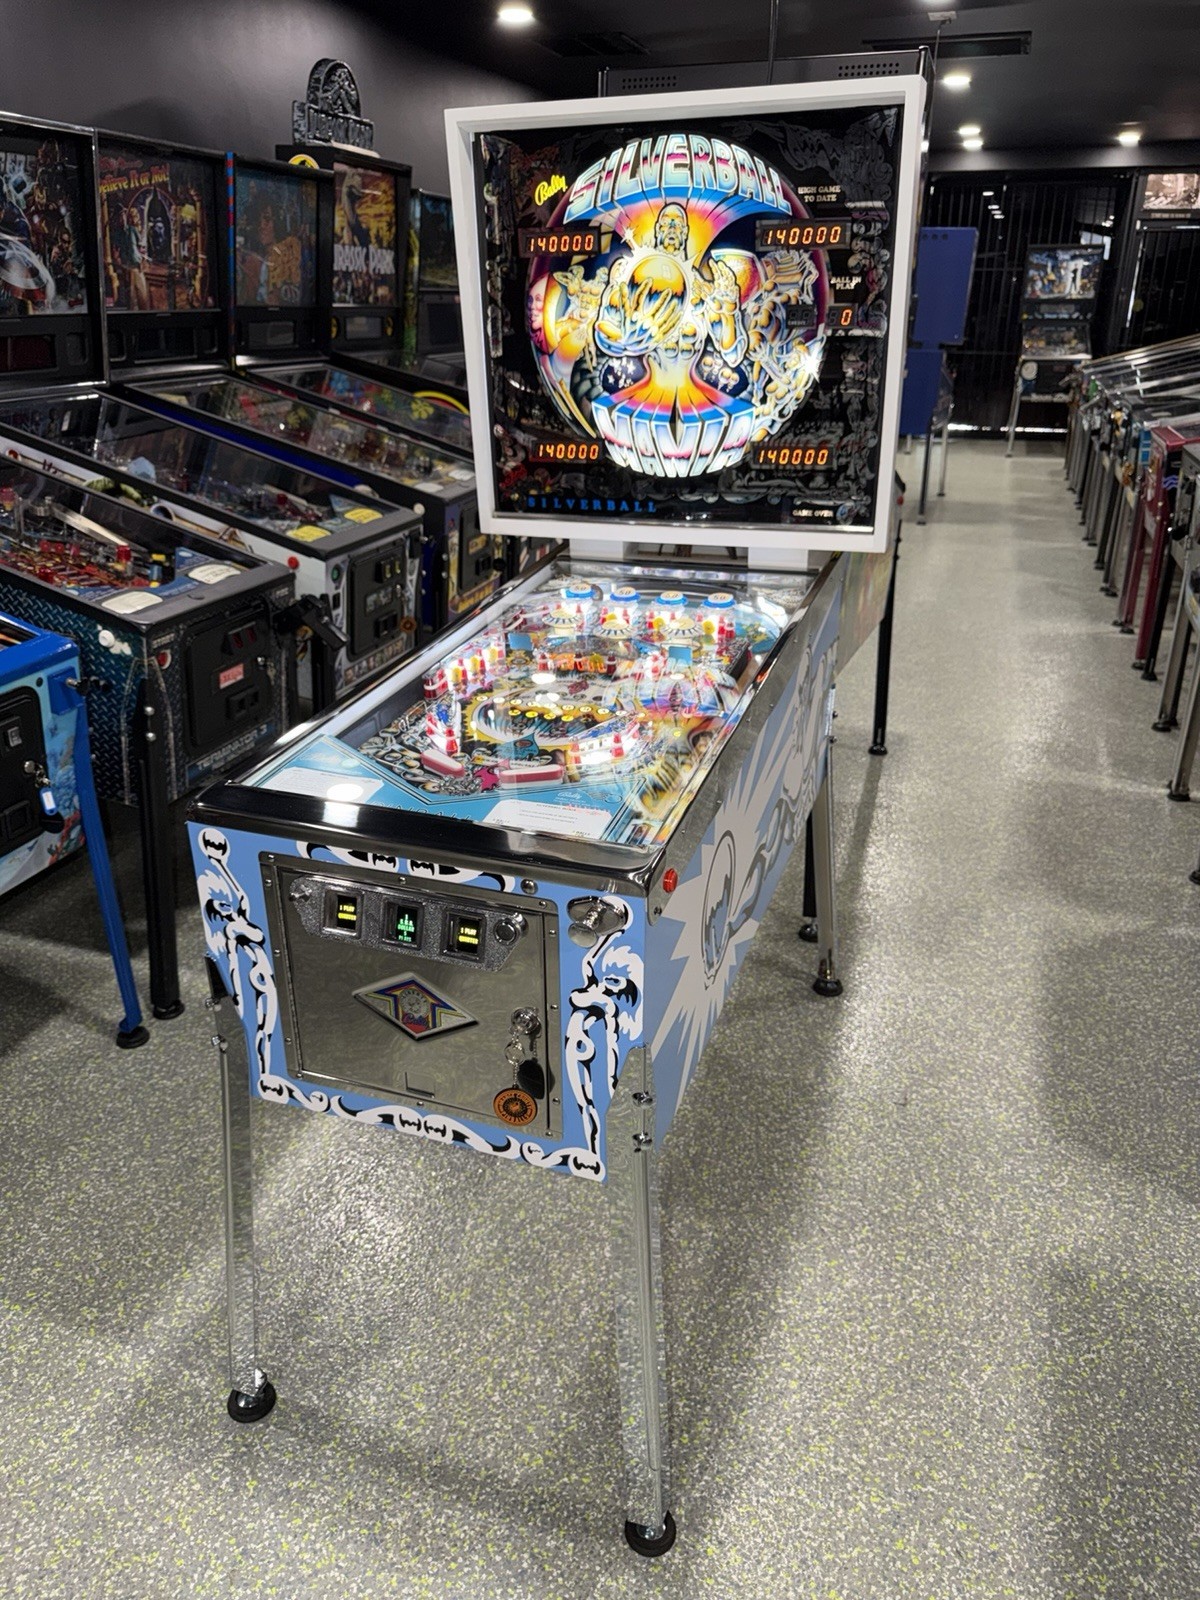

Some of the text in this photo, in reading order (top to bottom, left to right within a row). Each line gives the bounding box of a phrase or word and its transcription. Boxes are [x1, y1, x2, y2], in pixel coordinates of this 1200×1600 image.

[563, 133, 793, 225] SILVERBALL
[534, 174, 568, 206] Bally
[816, 194, 837, 202] DATE
[818, 185, 841, 193] GAME
[528, 233, 595, 253] 140000
[765, 225, 842, 246] 140000
[840, 309, 853, 326] 0
[591, 402, 756, 478] MANIA
[536, 443, 599, 461] 140000
[757, 448, 830, 466] 140000
[527, 496, 657, 514] SILVERBALL
